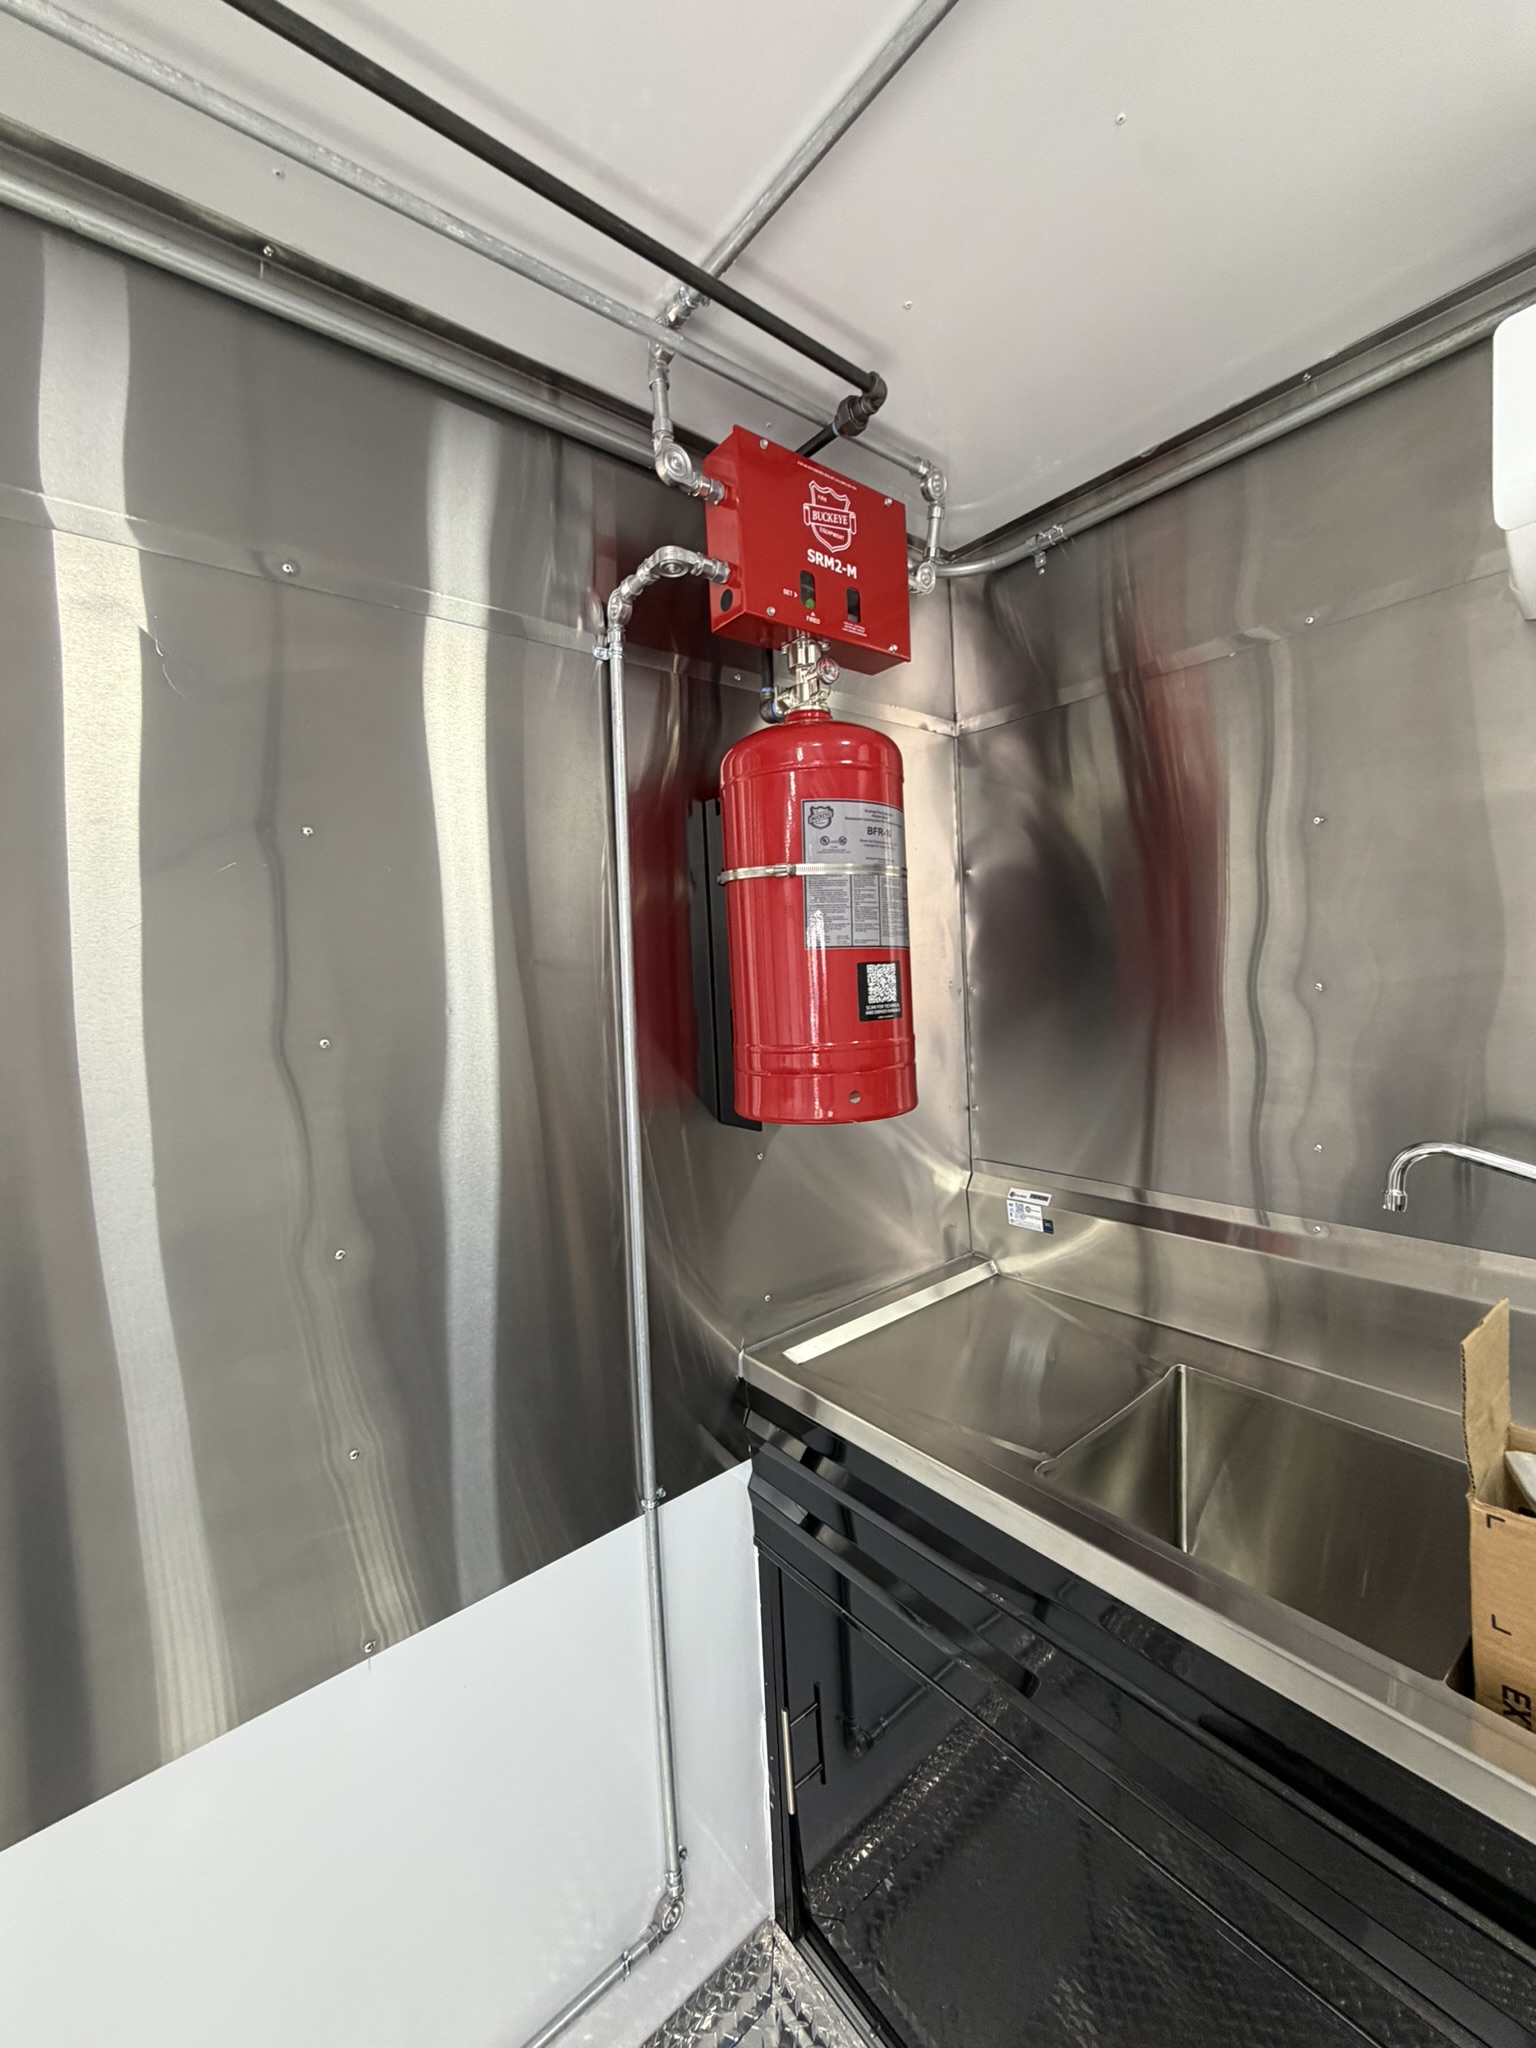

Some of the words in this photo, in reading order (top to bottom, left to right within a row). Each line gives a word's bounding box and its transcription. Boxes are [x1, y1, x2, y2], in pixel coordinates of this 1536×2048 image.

[812, 510, 849, 525] BUCKEYE
[819, 526, 845, 541] EQUIPMENT
[807, 548, 857, 579] SRM2-M
[1502, 1684, 1532, 1729] EX
